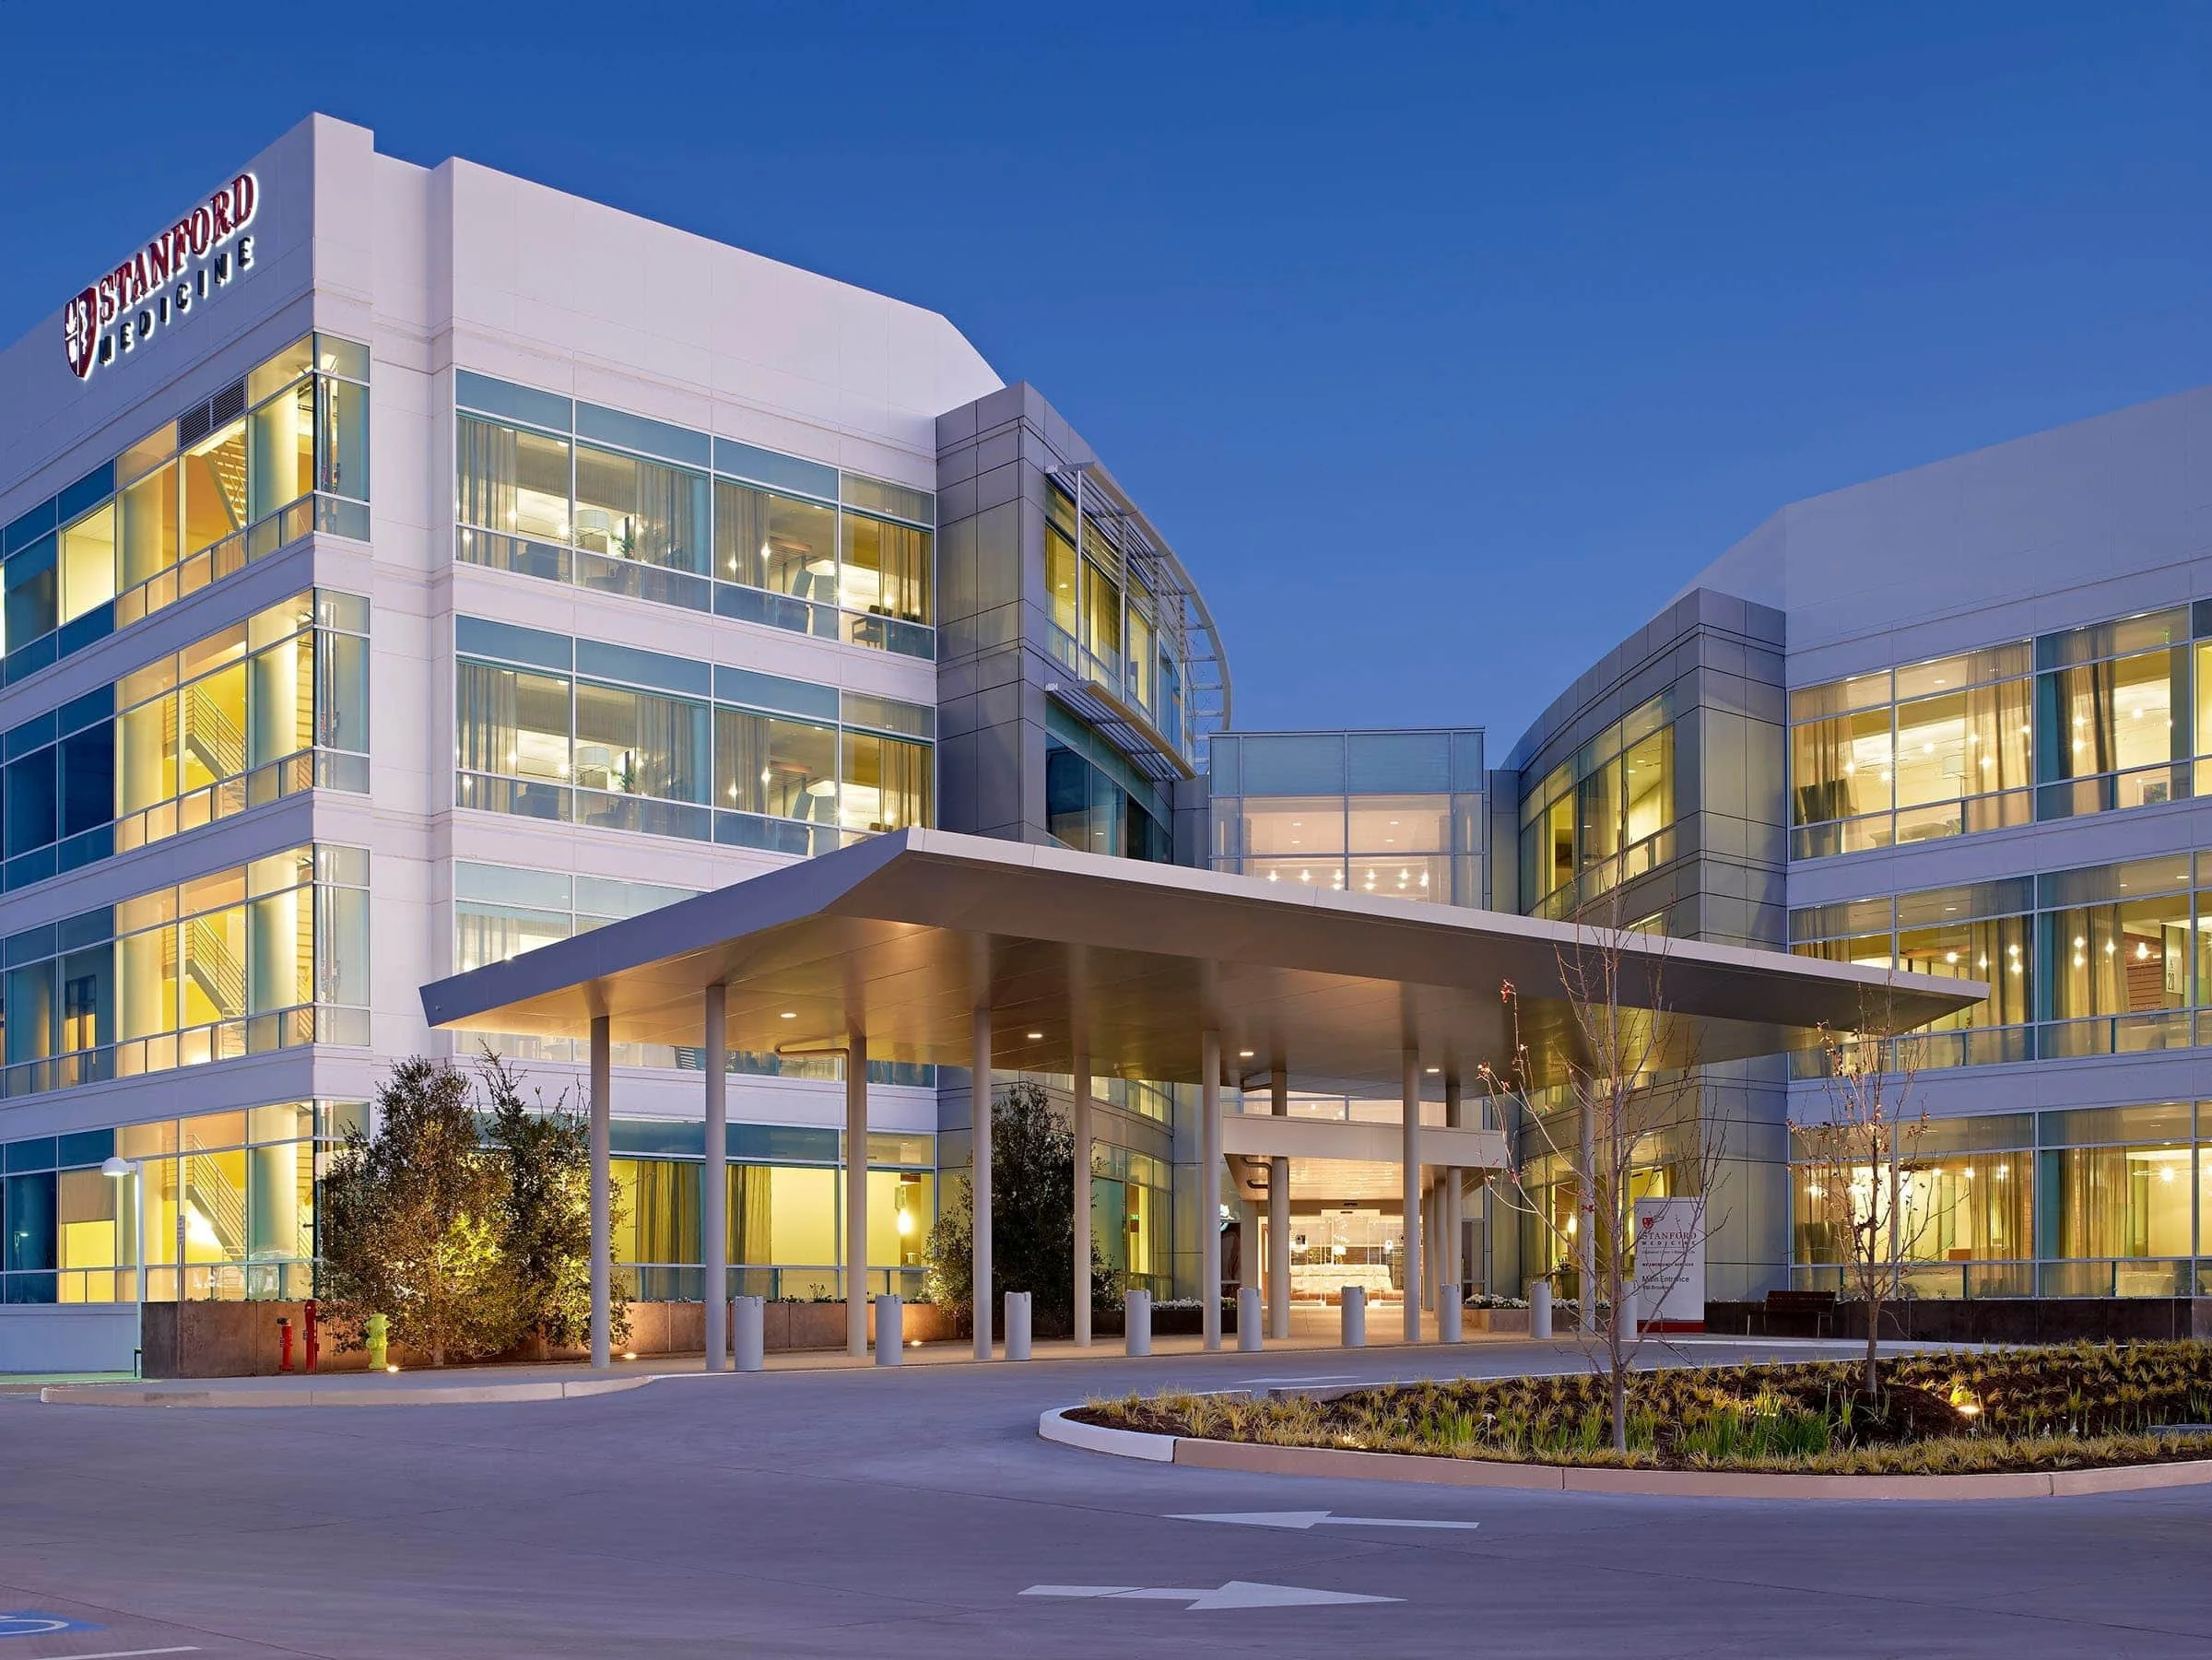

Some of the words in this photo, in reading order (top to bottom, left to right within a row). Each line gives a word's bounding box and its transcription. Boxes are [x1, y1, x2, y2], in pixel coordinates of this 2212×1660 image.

[98, 173, 255, 325] STANFORD
[98, 236, 253, 366] MEDICINE
[1641, 1231, 1697, 1240] STANFORD
